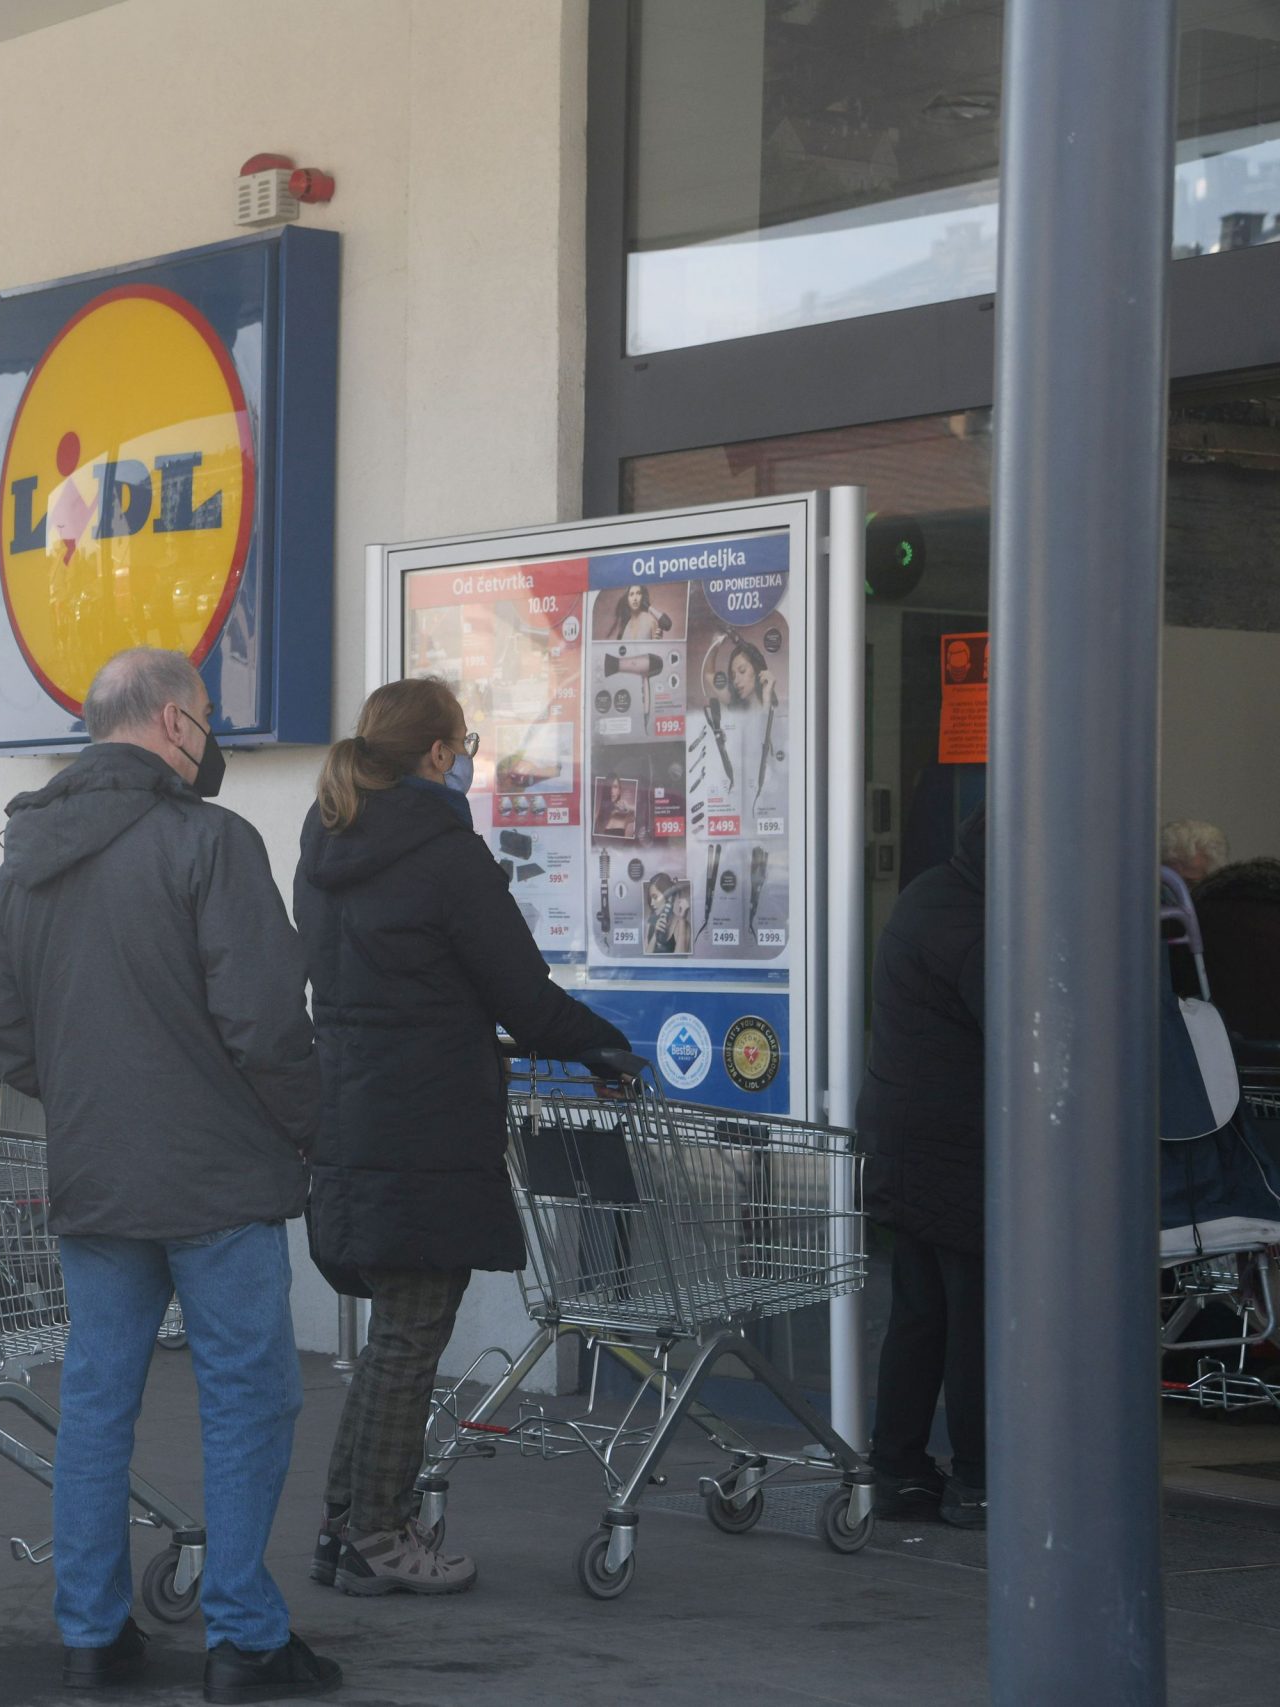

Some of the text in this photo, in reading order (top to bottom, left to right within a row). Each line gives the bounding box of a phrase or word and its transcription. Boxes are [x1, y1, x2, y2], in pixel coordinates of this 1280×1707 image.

[633, 548, 746, 578] Od ponedeljka
[452, 570, 535, 596] Od četvrtka
[709, 574, 782, 593] OD PONEDELJKA
[528, 596, 559, 614] 10.03.
[727, 592, 763, 611] 07.03.
[671, 1044, 698, 1059] BestBuy
[726, 1041, 738, 1079] BECAUSE
[765, 1030, 777, 1049] CARE
[744, 1081, 760, 1089] LIDL
